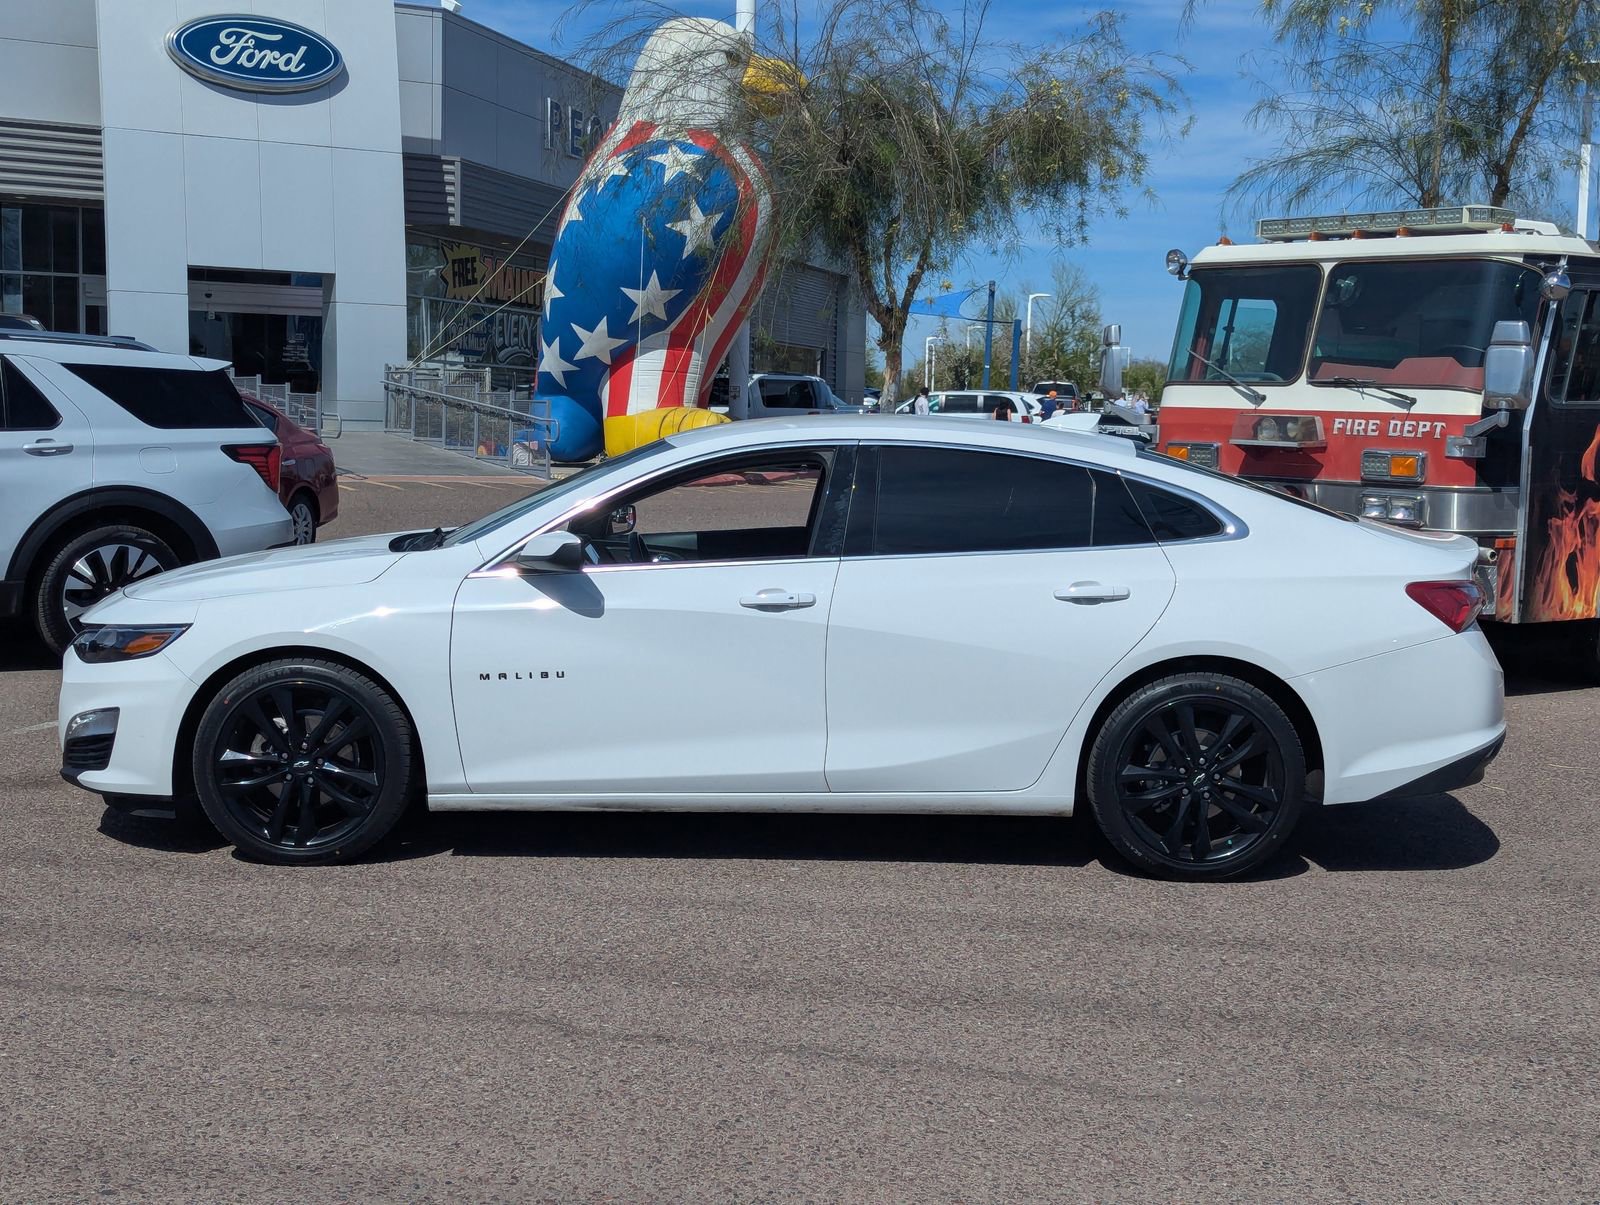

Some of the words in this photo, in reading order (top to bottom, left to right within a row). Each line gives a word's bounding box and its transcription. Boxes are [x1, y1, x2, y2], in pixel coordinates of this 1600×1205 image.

[210, 28, 308, 73] Ford
[544, 97, 613, 160] PEO
[452, 257, 478, 288] FREE
[496, 312, 533, 348] EVERY
[1333, 418, 1380, 436] FIRE
[1387, 419, 1447, 439] DEPT
[479, 671, 565, 681] MALIBU
